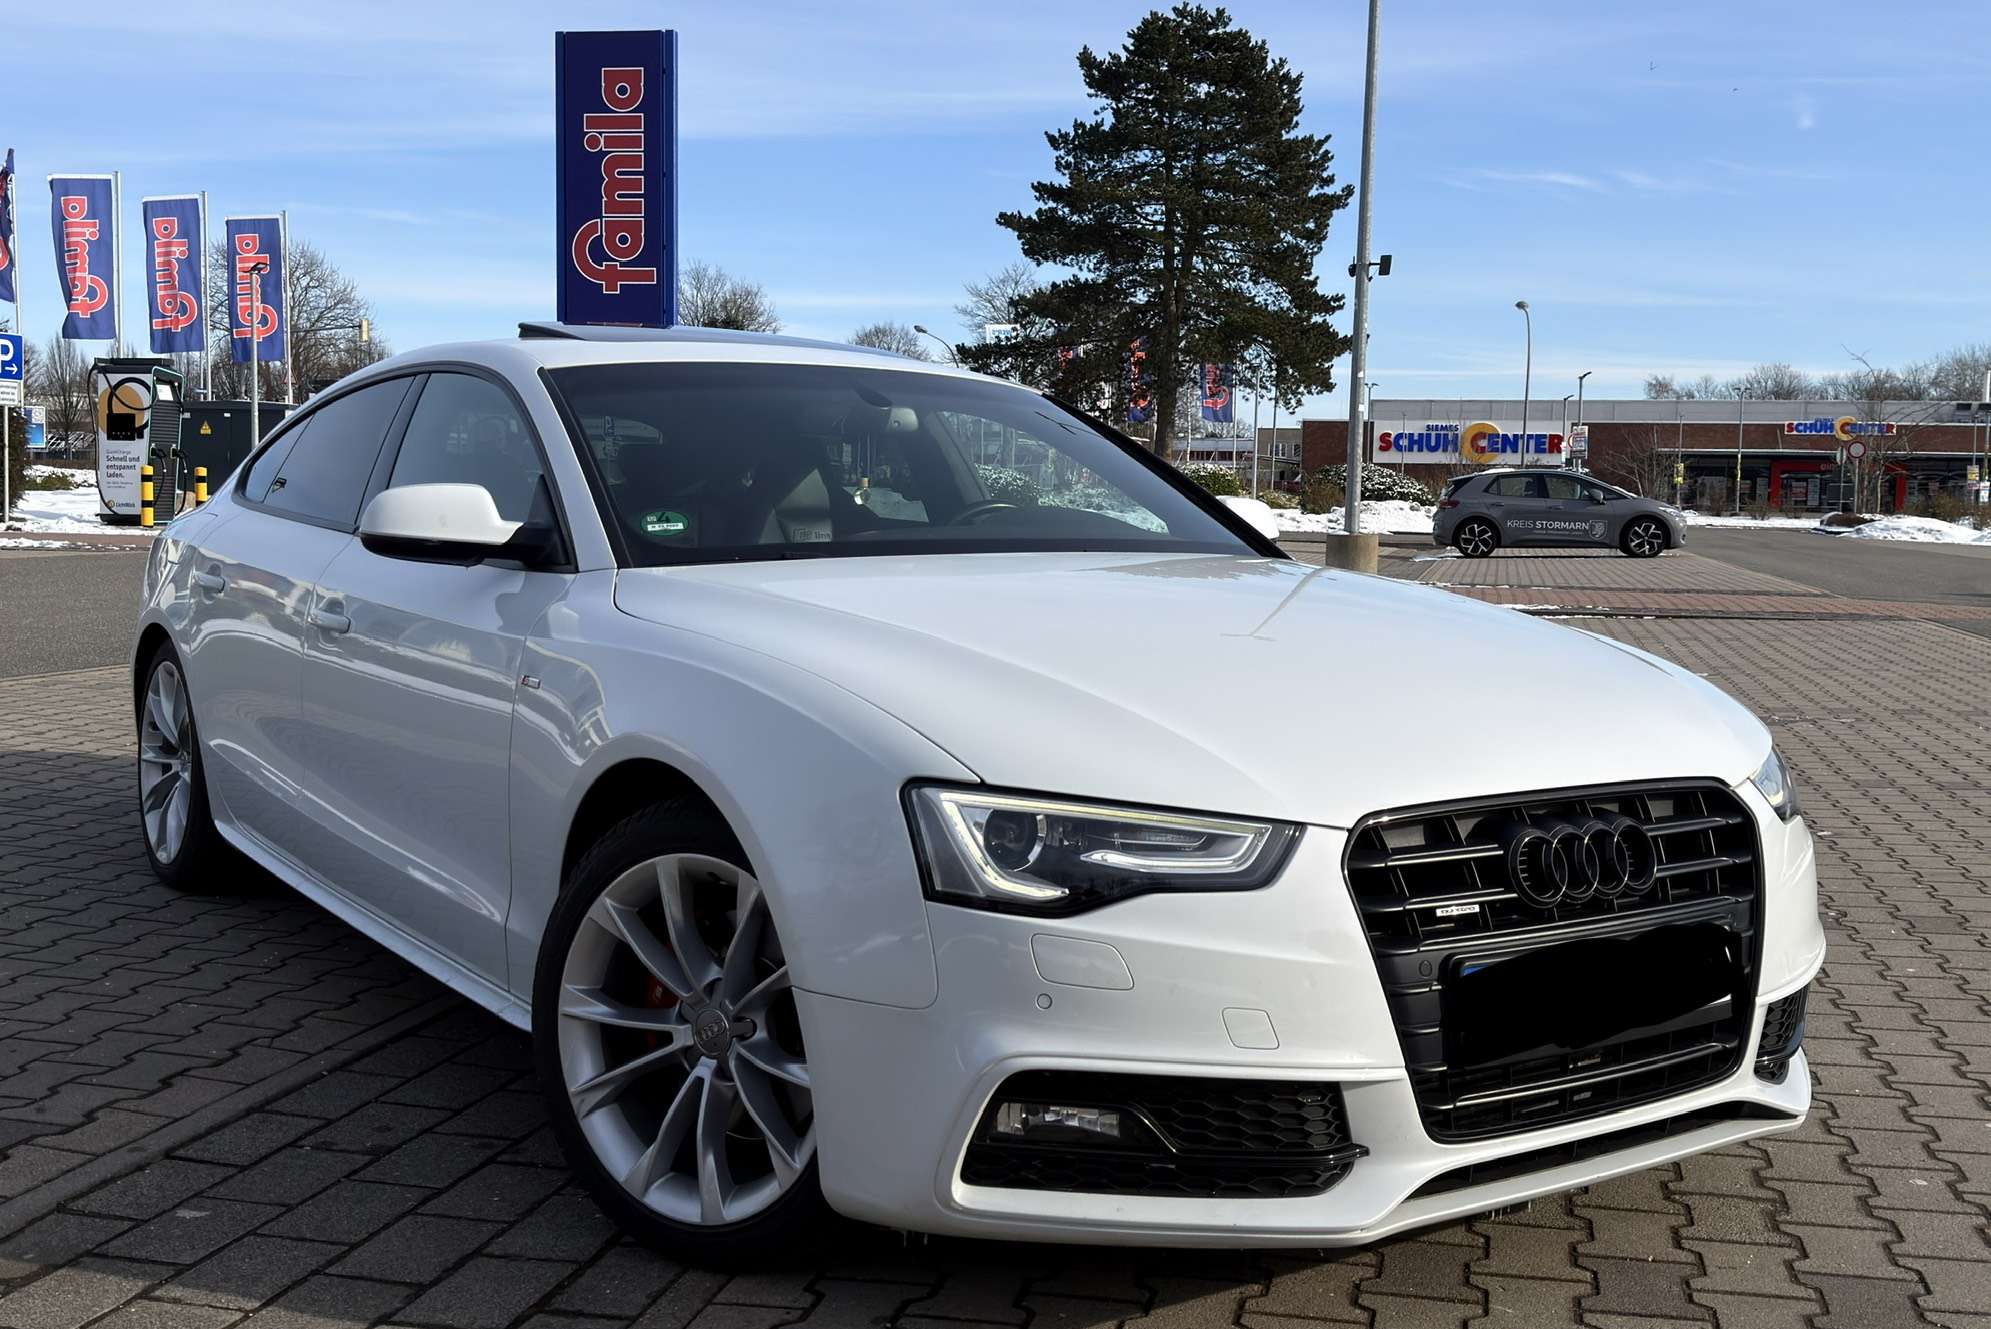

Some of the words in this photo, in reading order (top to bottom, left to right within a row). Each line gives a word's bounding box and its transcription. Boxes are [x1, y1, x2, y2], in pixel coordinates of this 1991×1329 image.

[572, 67, 656, 294] famila
[1426, 424, 1460, 432] SIEMES
[1786, 423, 1835, 434] SCHUH
[1379, 432, 1459, 453] SCHUH
[1470, 431, 1564, 454] CENTER
[128, 455, 140, 463] und
[1507, 520, 1534, 529] KREIS
[1535, 520, 1590, 530] STORMARN
